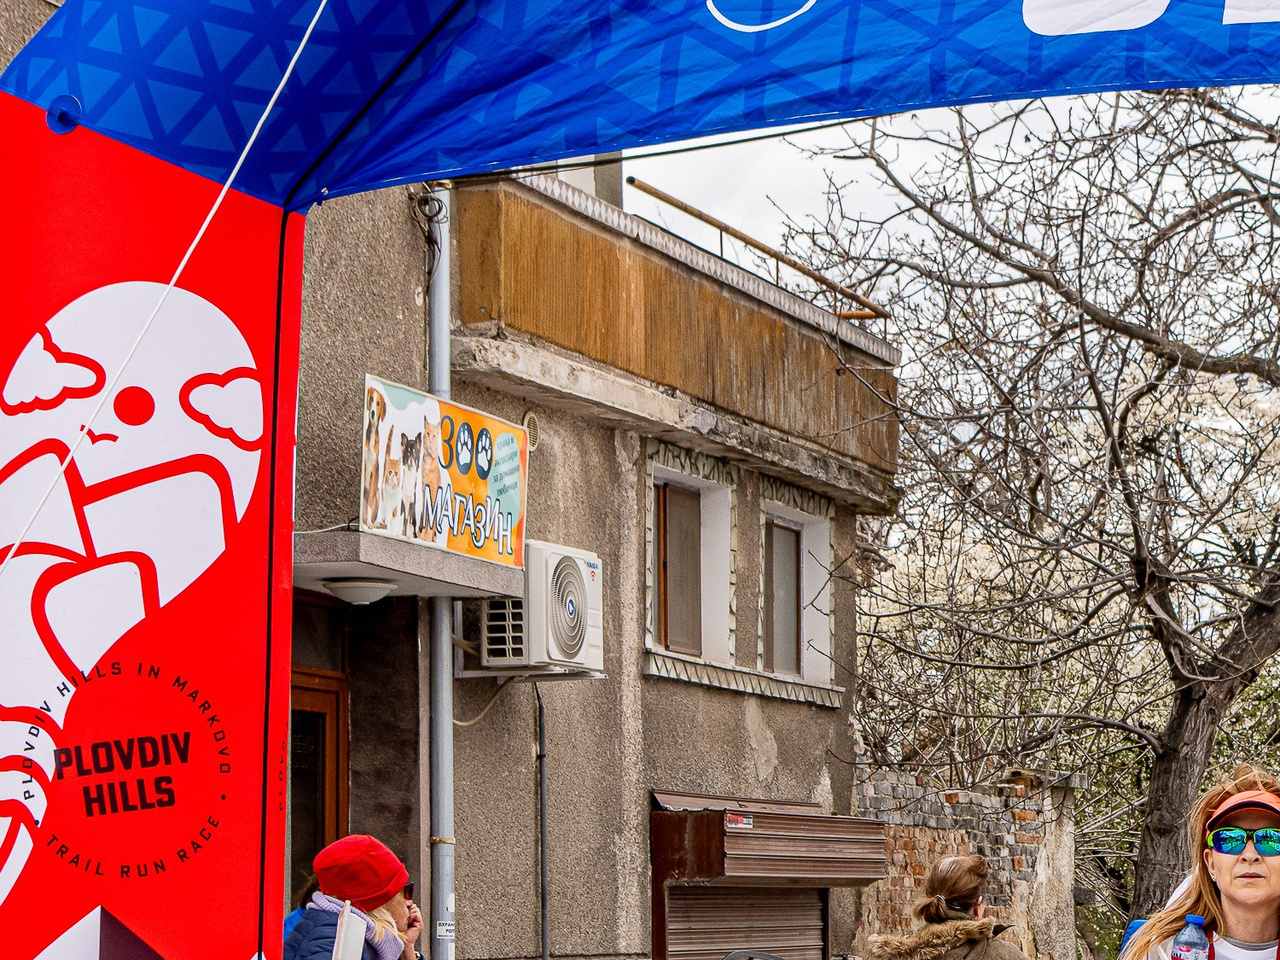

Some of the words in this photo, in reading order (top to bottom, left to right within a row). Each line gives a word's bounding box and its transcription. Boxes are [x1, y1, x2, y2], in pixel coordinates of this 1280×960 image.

[438, 415, 493, 480] ЗОО
[421, 483, 513, 555] МАГАЗИН
[22, 700, 52, 801] PLOVDIV
[56, 662, 122, 697] HILLS
[138, 663, 160, 679] IN
[172, 675, 231, 774] MARKOVO
[53, 731, 191, 780] PLOVDIV
[82, 775, 176, 818] HILLS
[46, 834, 104, 876] TRAIL
[120, 860, 167, 878] RUN
[176, 815, 220, 863] RACE
